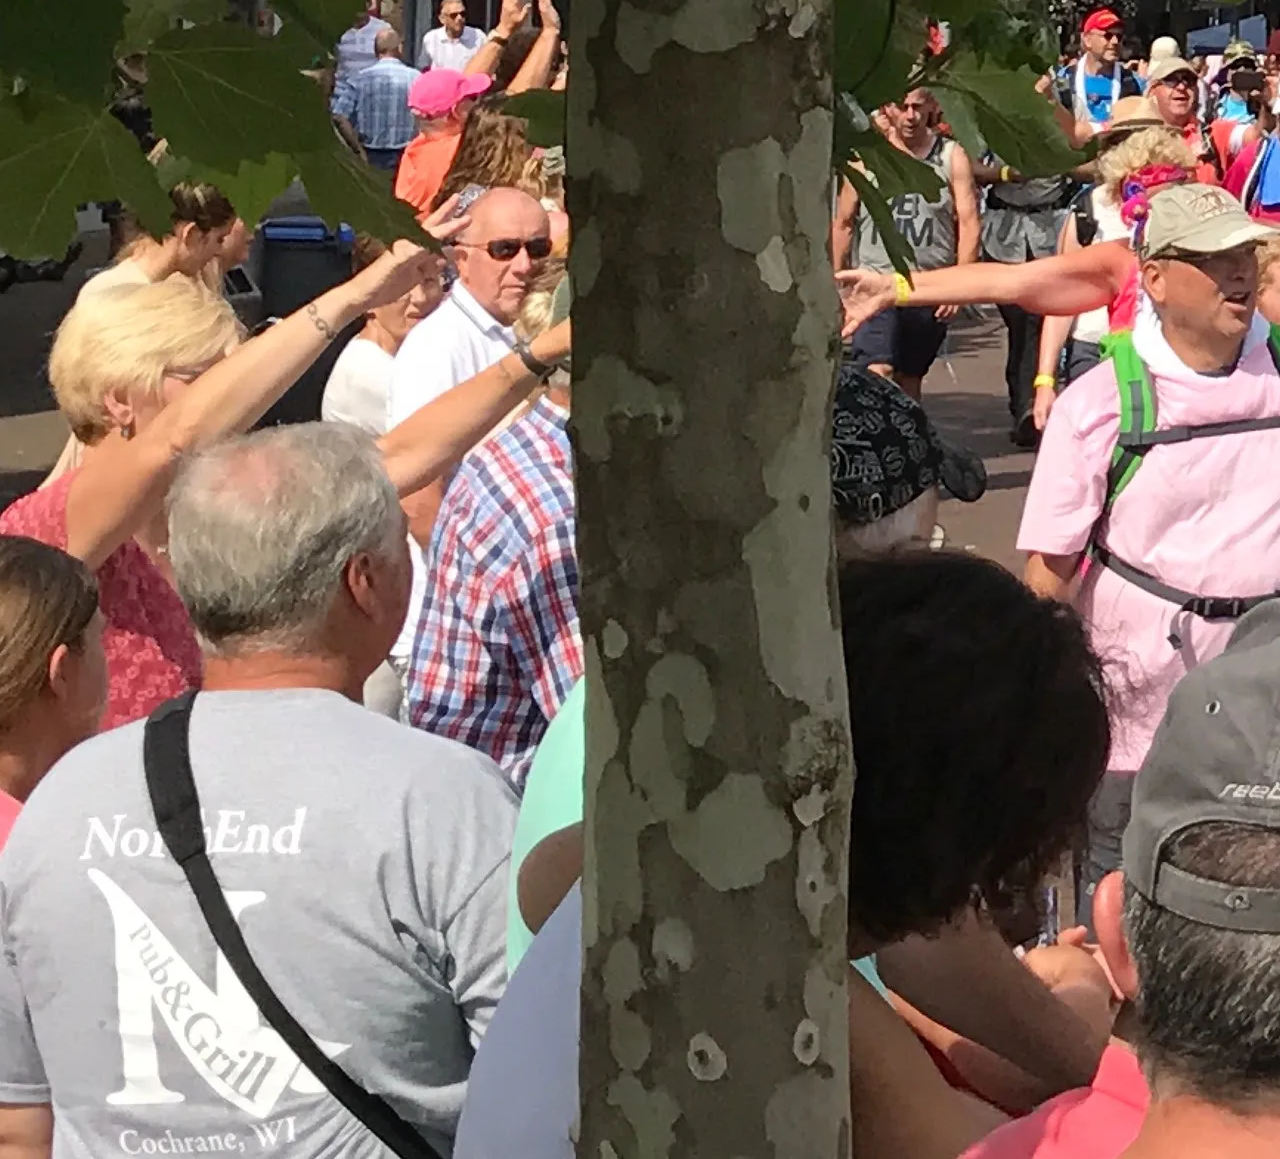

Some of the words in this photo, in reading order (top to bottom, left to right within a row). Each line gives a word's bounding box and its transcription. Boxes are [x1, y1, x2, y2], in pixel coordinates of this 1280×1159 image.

[79, 805, 308, 861] NorhEnd
[118, 1129, 247, 1155] Cochrane,
[251, 1116, 298, 1148] WI
